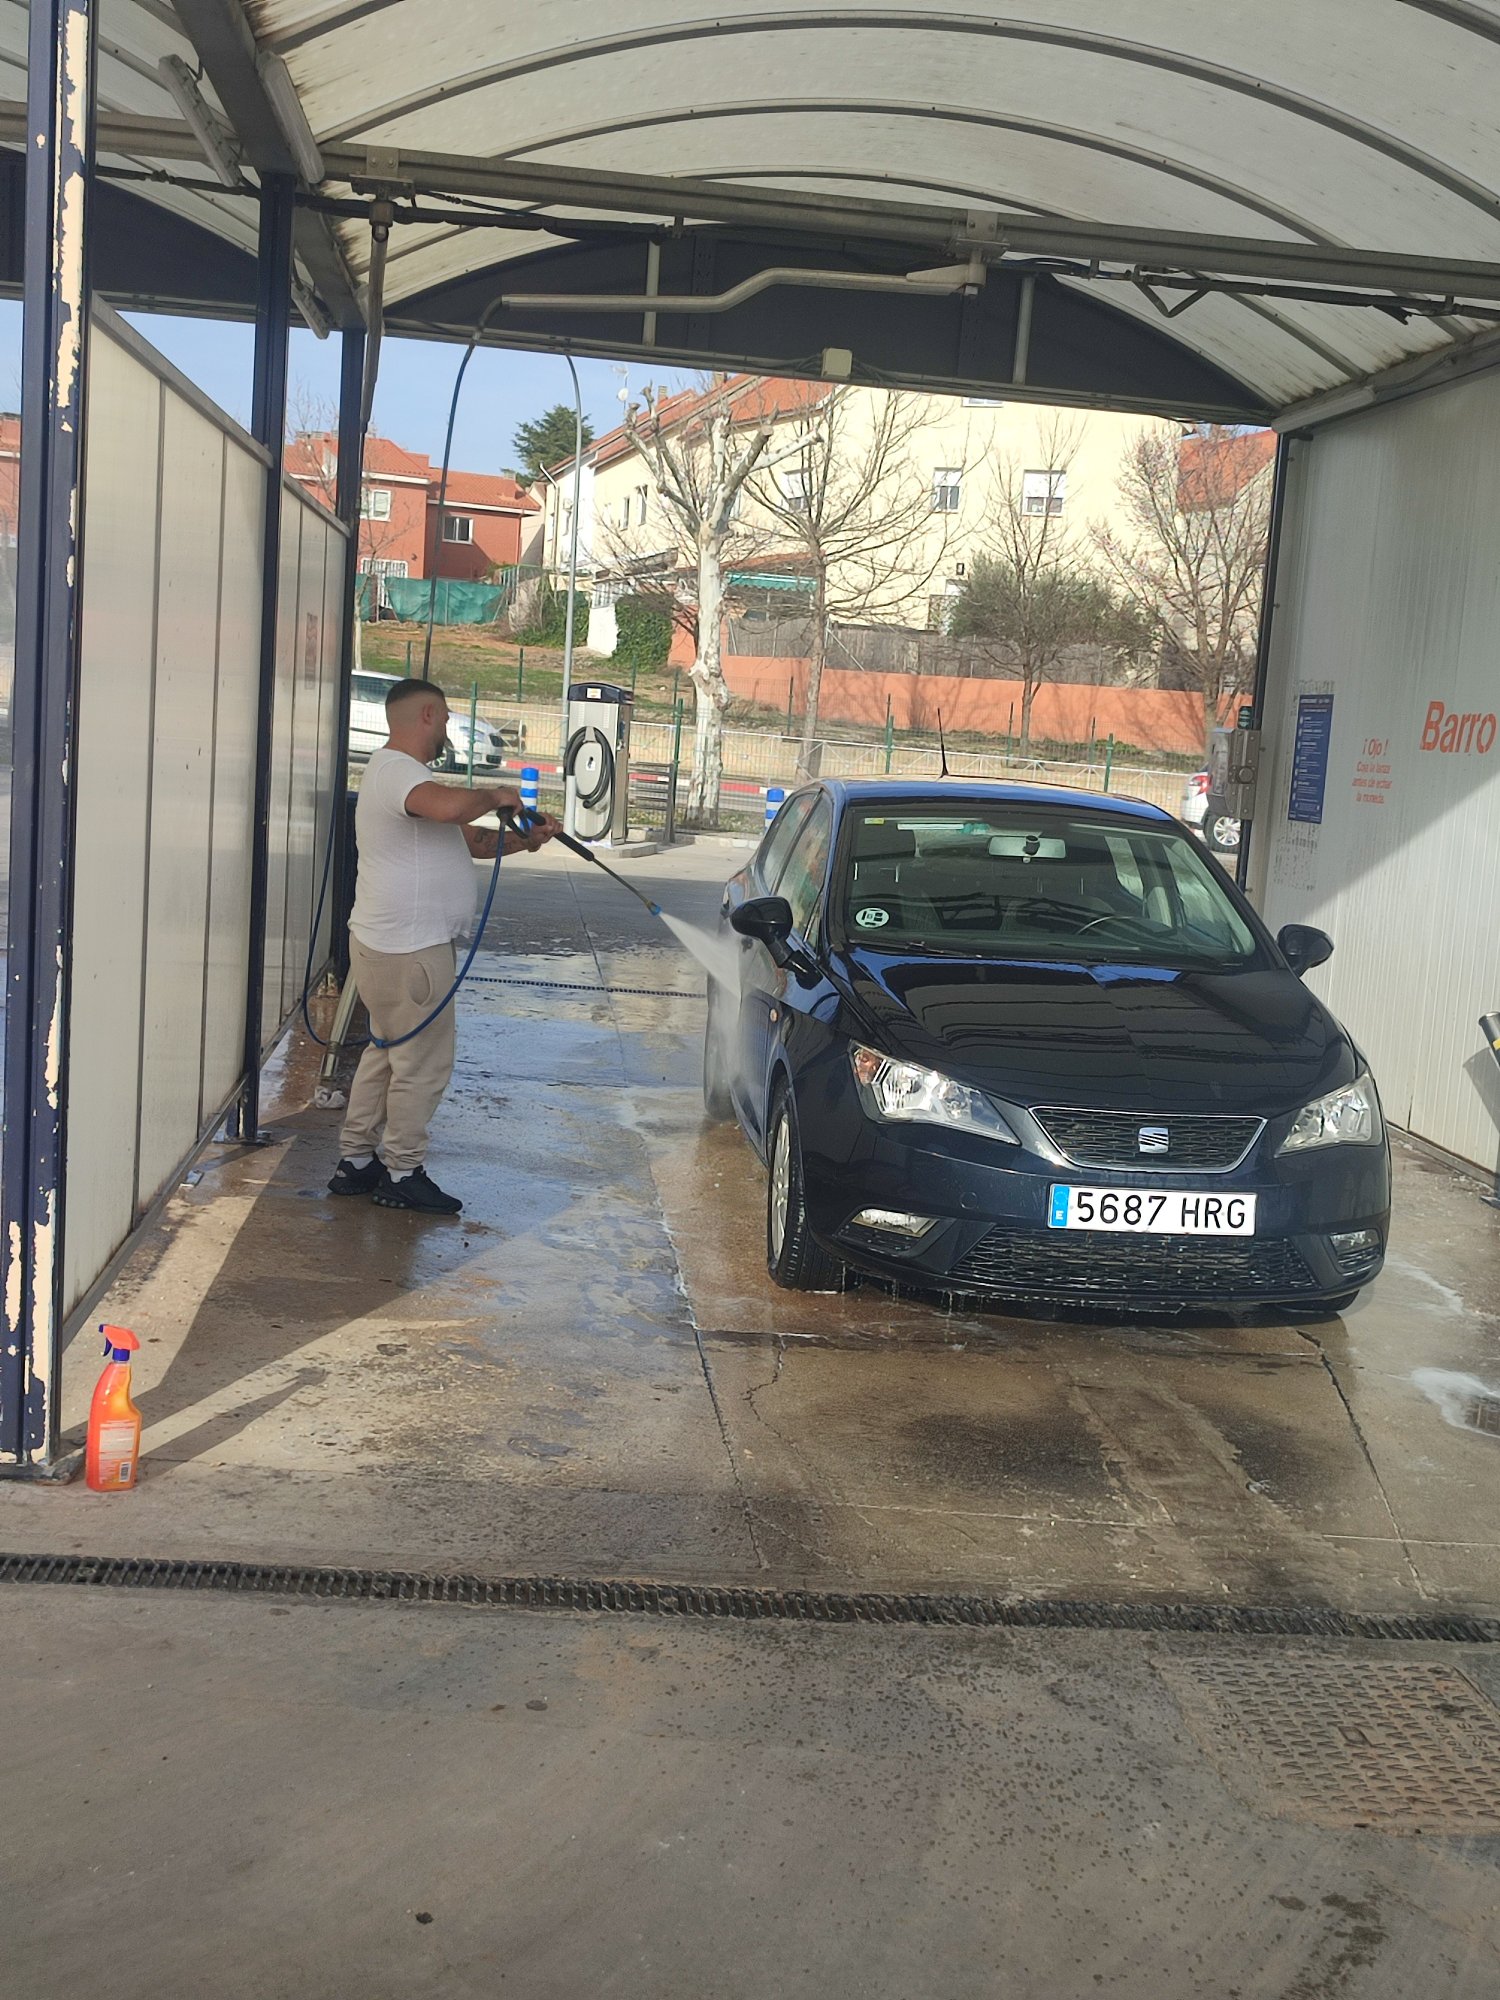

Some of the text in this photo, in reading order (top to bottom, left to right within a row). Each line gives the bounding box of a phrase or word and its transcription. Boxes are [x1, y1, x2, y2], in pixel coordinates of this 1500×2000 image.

[1420, 701, 1497, 754] Barro
[1055, 1210, 1064, 1220] E
[1077, 1191, 1245, 1229] 5687 HRG
